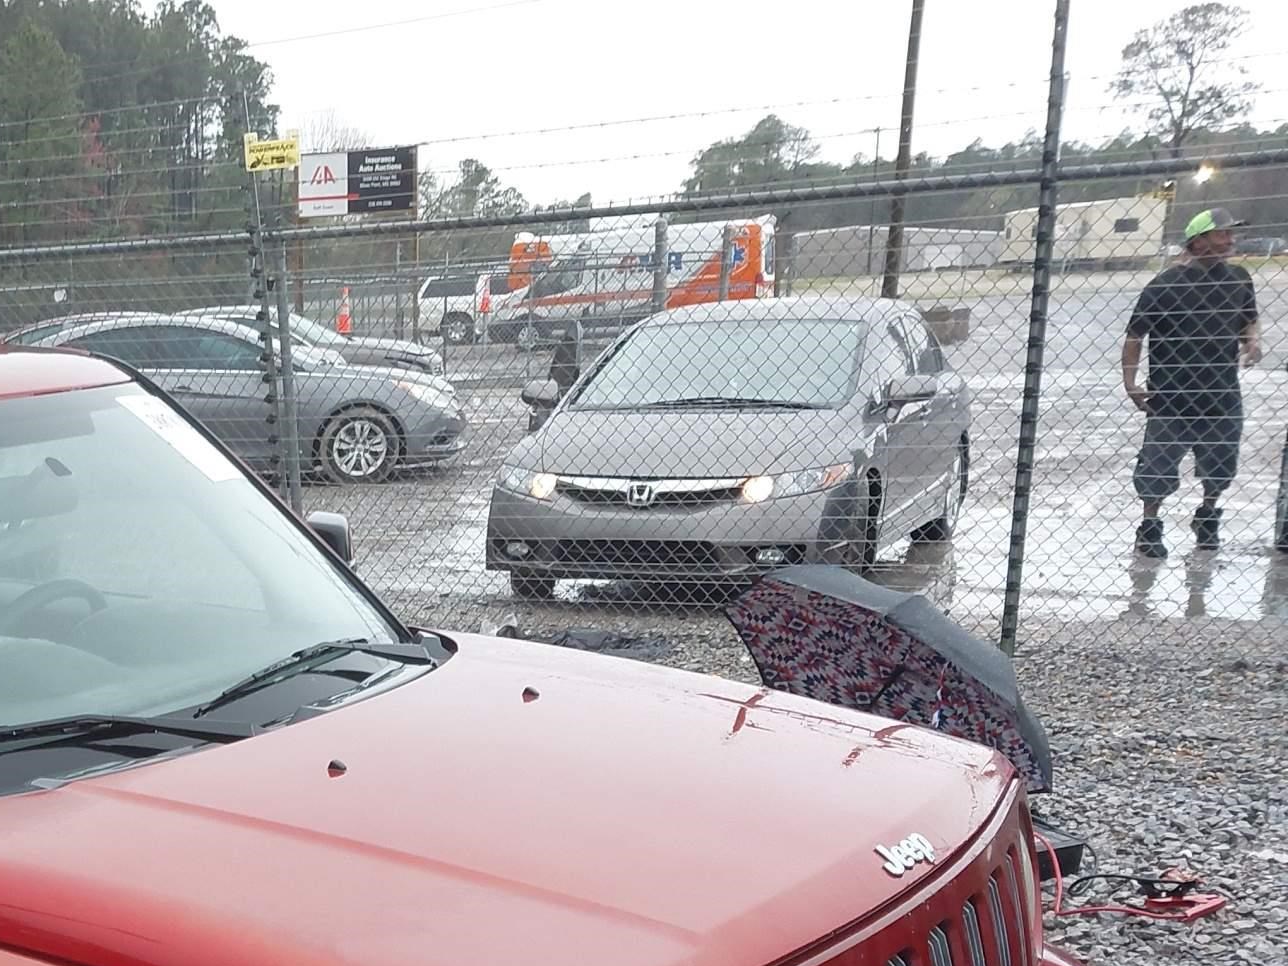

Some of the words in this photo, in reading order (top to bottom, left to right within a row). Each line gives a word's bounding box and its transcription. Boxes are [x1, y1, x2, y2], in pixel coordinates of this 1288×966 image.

[364, 155, 396, 164] Insurance
[358, 164, 374, 173] Auto
[374, 163, 402, 172] Auctions
[873, 832, 937, 878] Jeep
